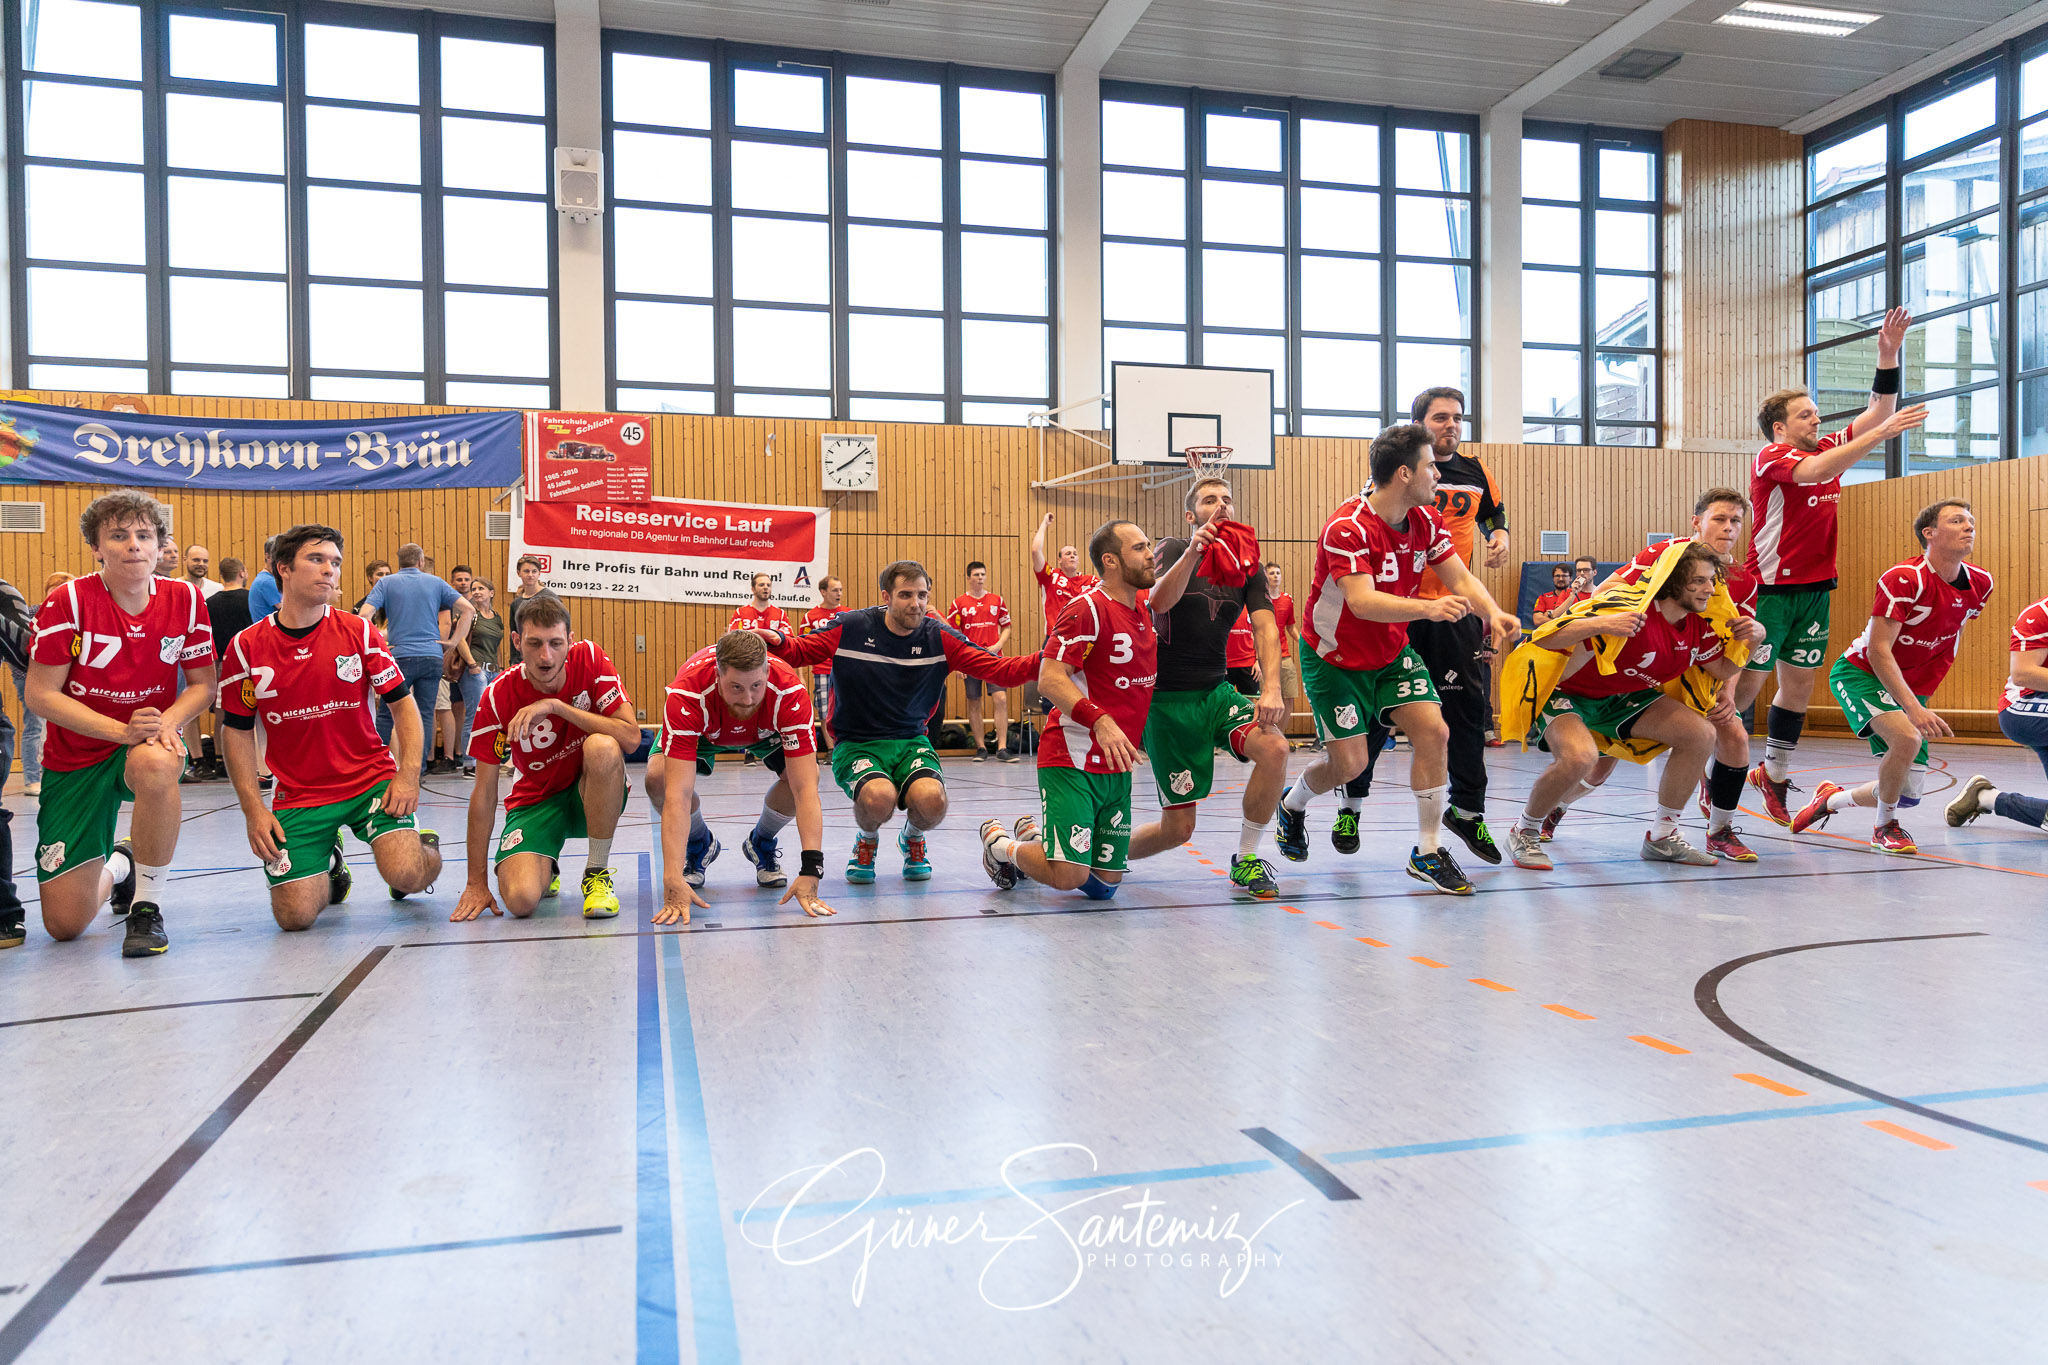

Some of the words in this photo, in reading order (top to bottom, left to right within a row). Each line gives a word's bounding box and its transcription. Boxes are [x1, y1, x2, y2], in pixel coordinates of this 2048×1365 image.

[543, 416, 587, 426] Fahrschule
[575, 416, 614, 435] Schlicht
[622, 426, 641, 441] 45
[73, 422, 473, 480] Dreykorn-Bräu
[544, 472, 560, 482] 1965
[563, 467, 579, 477] 2010
[546, 482, 556, 490] 45
[555, 479, 571, 488] Jahre
[549, 485, 581, 499] Fahrschule
[580, 478, 604, 490] Schlicht
[576, 504, 718, 530] Reiseservice
[724, 515, 773, 533] Lauf
[570, 526, 588, 536] Ihre
[589, 528, 629, 539] regionale
[630, 532, 644, 540] DB
[645, 531, 679, 543] Agentur
[680, 534, 691, 543] im
[693, 535, 728, 546] Bahnhof
[729, 538, 748, 547] Lauf
[749, 540, 774, 548] rechts
[562, 560, 591, 571] Ihre
[595, 562, 636, 574] Profis
[640, 565, 661, 575] für
[664, 566, 699, 578] Bahn
[703, 569, 728, 580] und
[732, 570, 783, 583] Rein!
[1051, 572, 1068, 587] 13
[541, 580, 567, 590] efon:
[570, 581, 602, 591] 09123
[611, 584, 625, 592] 22
[627, 585, 640, 593] 21
[685, 589, 811, 603] www.bahnsere.lauf.de
[961, 606, 976, 617] 44
[742, 619, 758, 629] 34
[78, 631, 122, 669] 17
[911, 646, 922, 655] PW
[1109, 632, 1134, 665] 3
[1791, 648, 1821, 664] 20
[251, 666, 278, 699] 2
[1396, 678, 1429, 699] 33
[89, 687, 136, 698] MICHAEL
[282, 705, 320, 718] MICHAEL
[322, 699, 349, 710] WÖLFL
[519, 718, 557, 753] 18
[910, 757, 924, 769] 4
[1097, 843, 1114, 862] 3
